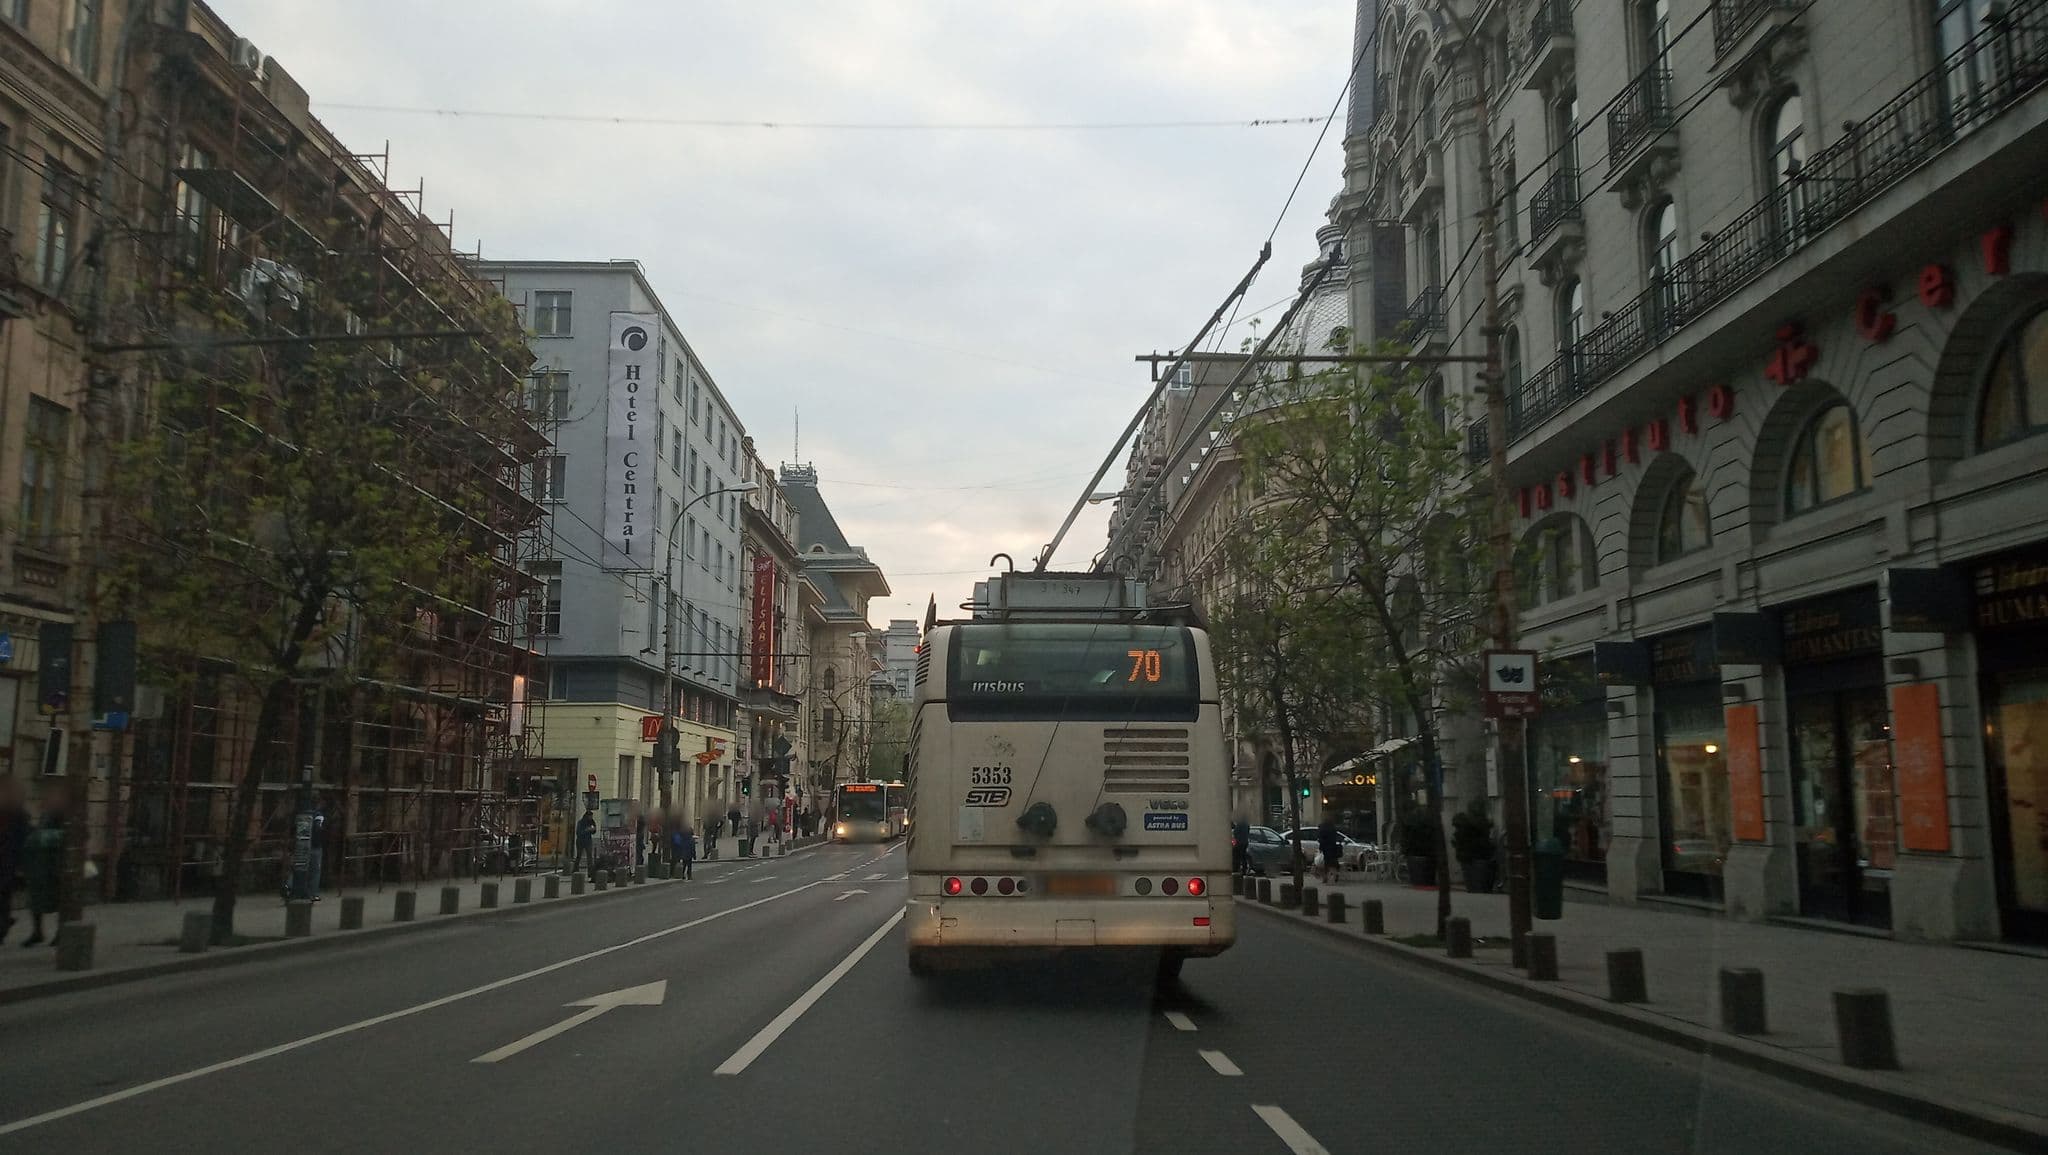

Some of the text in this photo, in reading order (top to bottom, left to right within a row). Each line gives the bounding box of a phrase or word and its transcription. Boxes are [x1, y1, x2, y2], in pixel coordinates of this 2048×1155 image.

[1518, 383, 1734, 519] Instituto
[1854, 196, 2048, 342] Cer
[623, 365, 641, 555] Hotel Central
[1128, 650, 1161, 682] 70
[972, 680, 1025, 693] irisbus
[972, 766, 1011, 784] 5353
[965, 789, 1008, 804] STB
